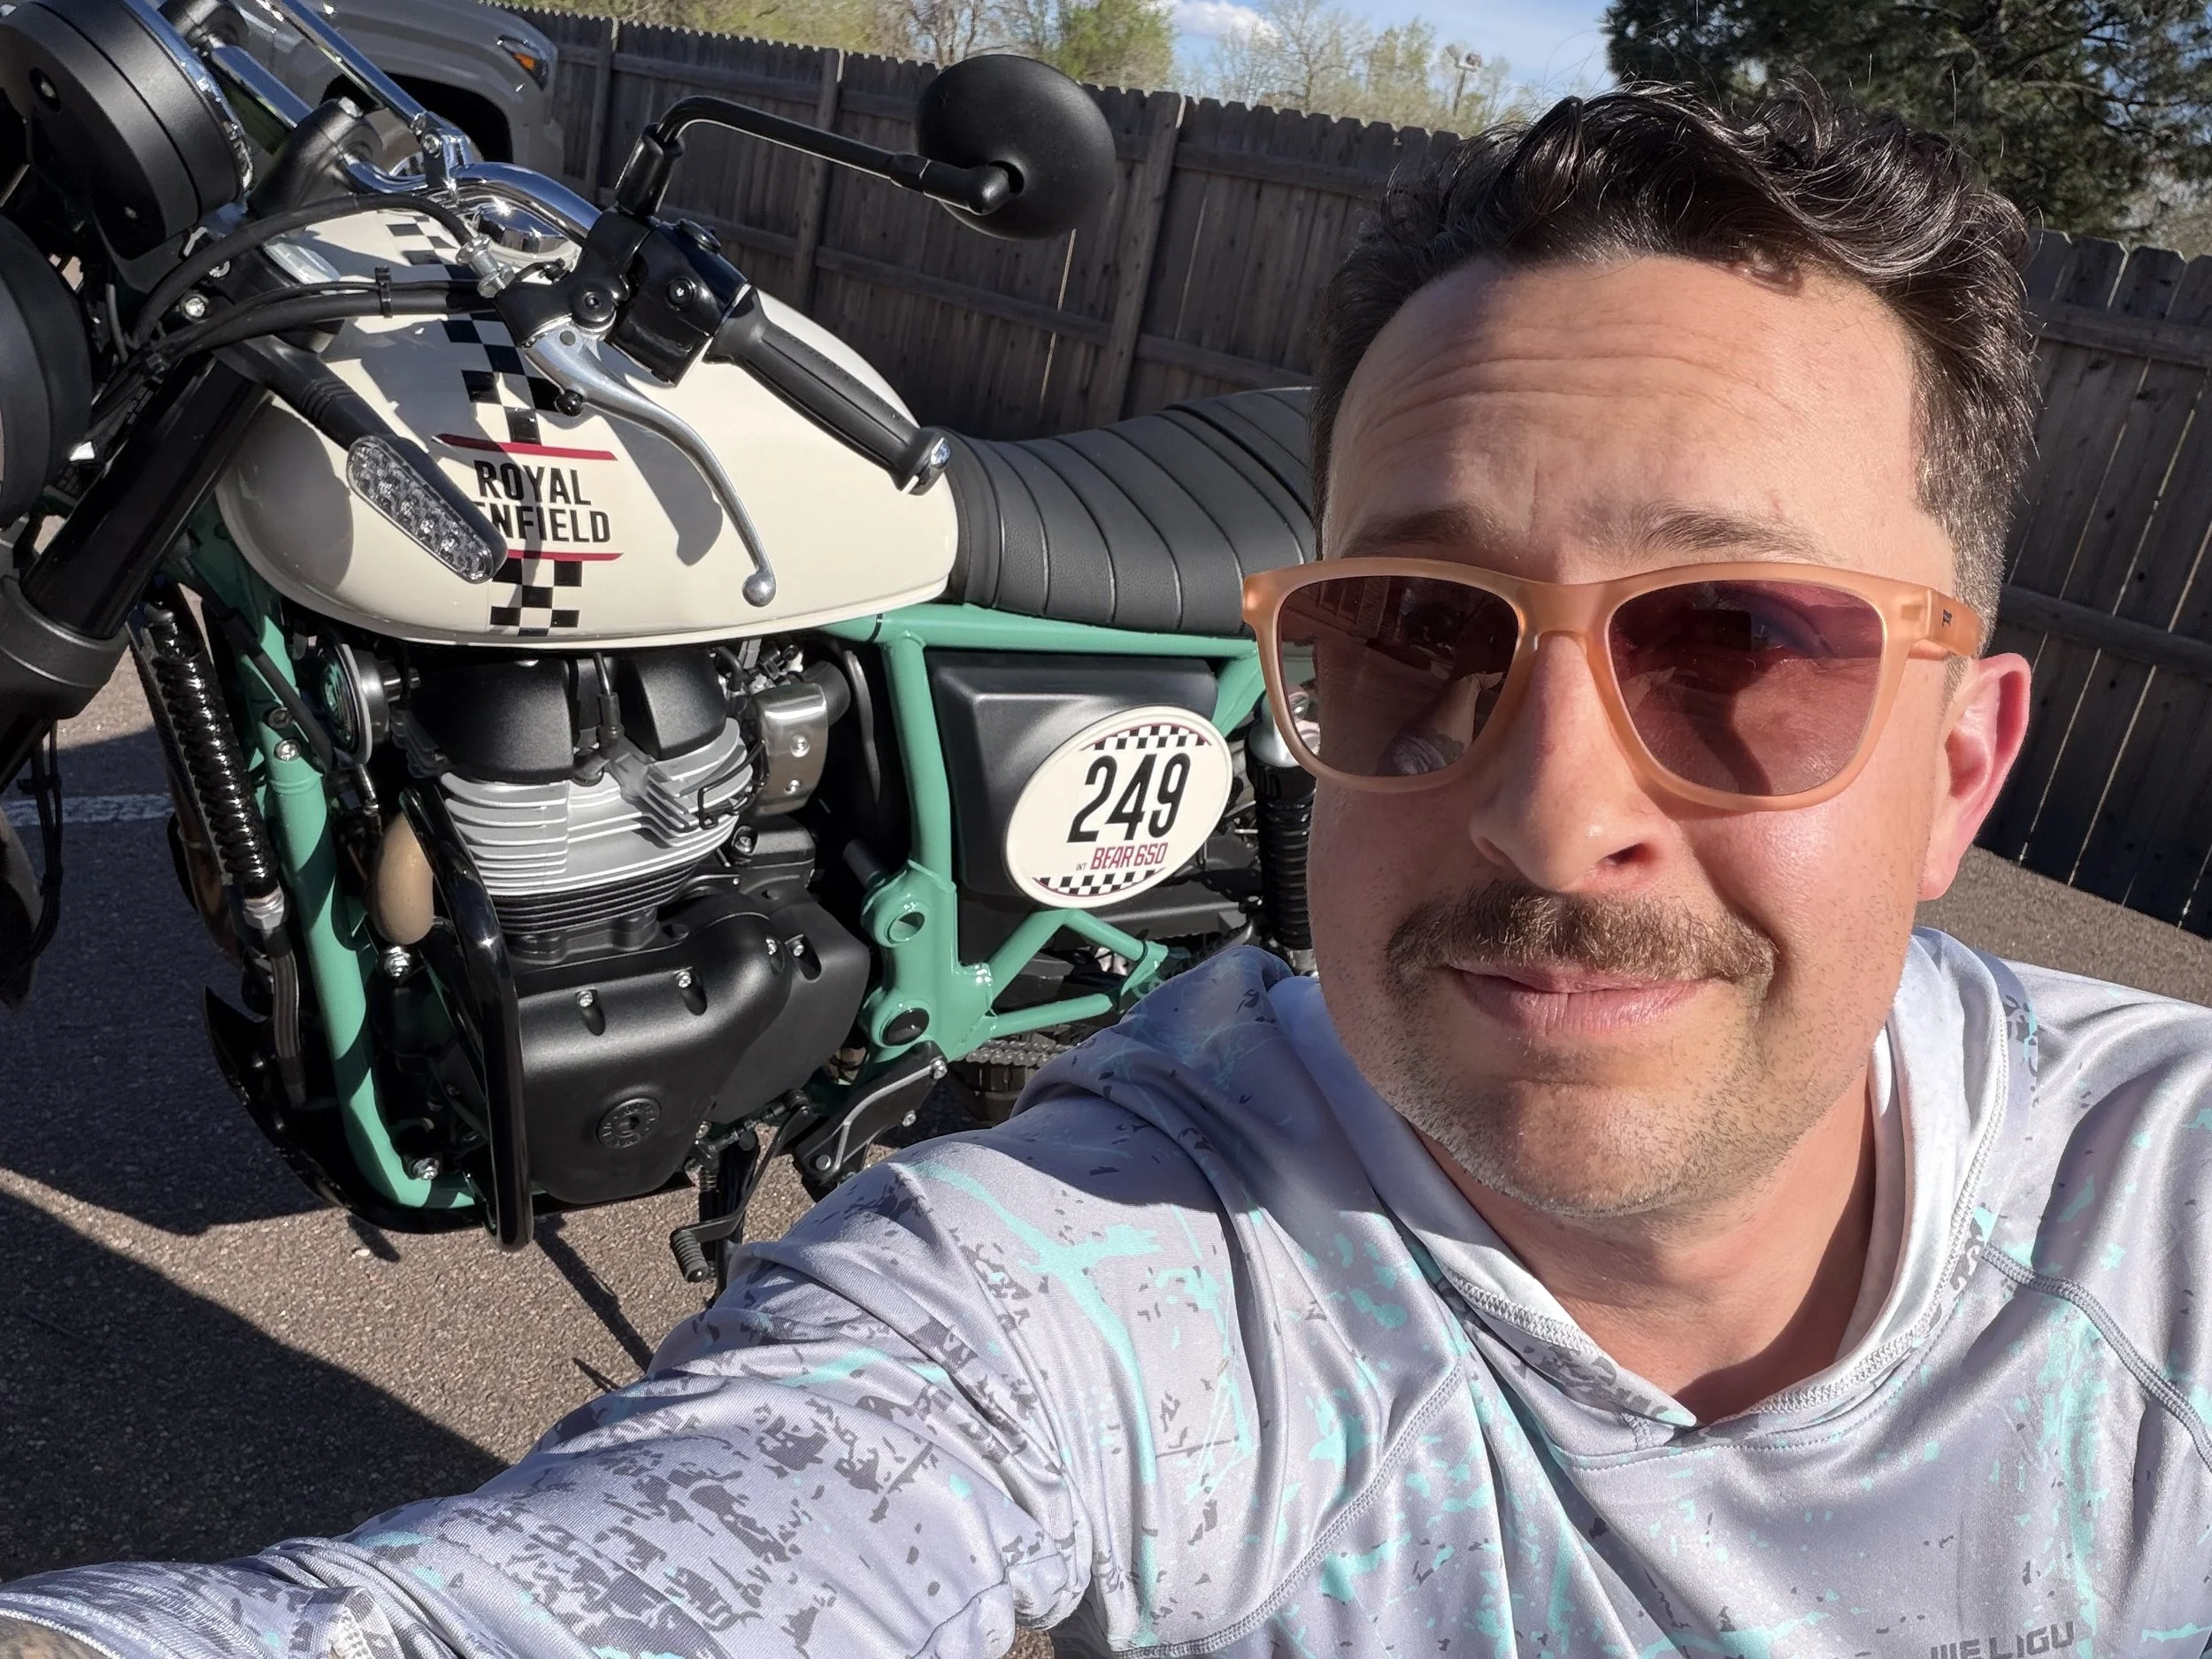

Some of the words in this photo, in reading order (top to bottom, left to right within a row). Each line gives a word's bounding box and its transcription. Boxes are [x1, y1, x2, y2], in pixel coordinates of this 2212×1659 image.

[473, 460, 591, 505] ROYAL
[472, 501, 611, 542] NFIELD
[1067, 753, 1191, 842] 249
[1090, 846, 1134, 870] BEAR
[1133, 842, 1168, 866] 650
